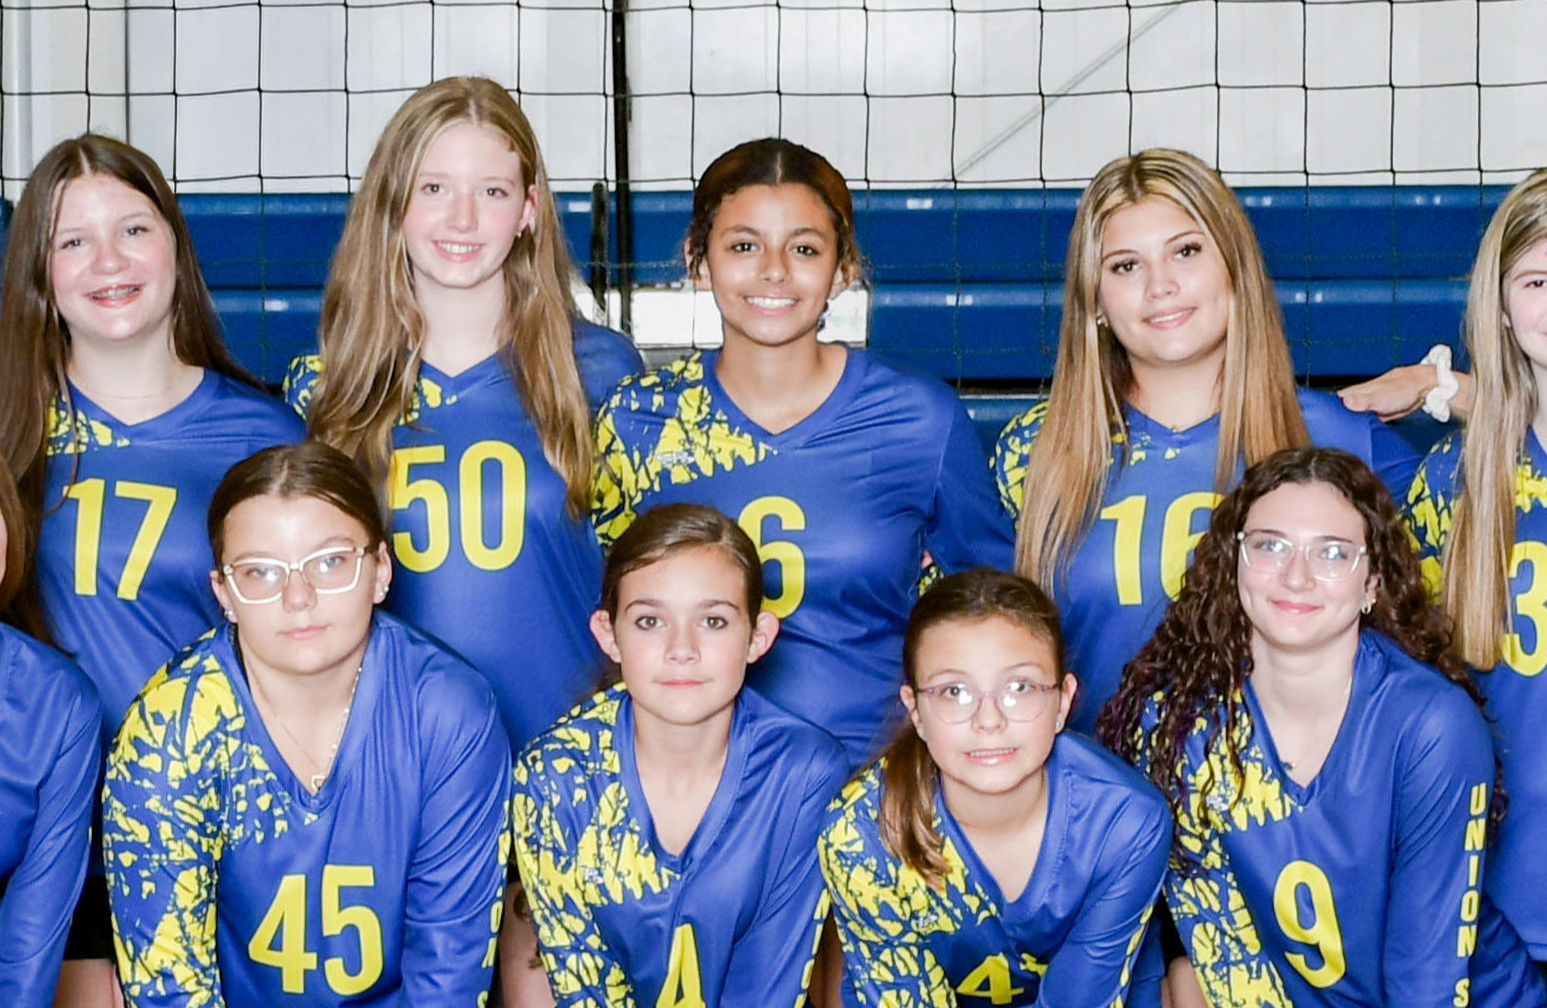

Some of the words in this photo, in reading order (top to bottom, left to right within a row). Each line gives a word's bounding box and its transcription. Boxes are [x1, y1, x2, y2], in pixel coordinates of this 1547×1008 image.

[62, 477, 177, 600] 17
[386, 440, 526, 572] 50
[247, 865, 384, 996] 45
[1272, 859, 1347, 989] 9
[1463, 782, 1488, 958] UNION
